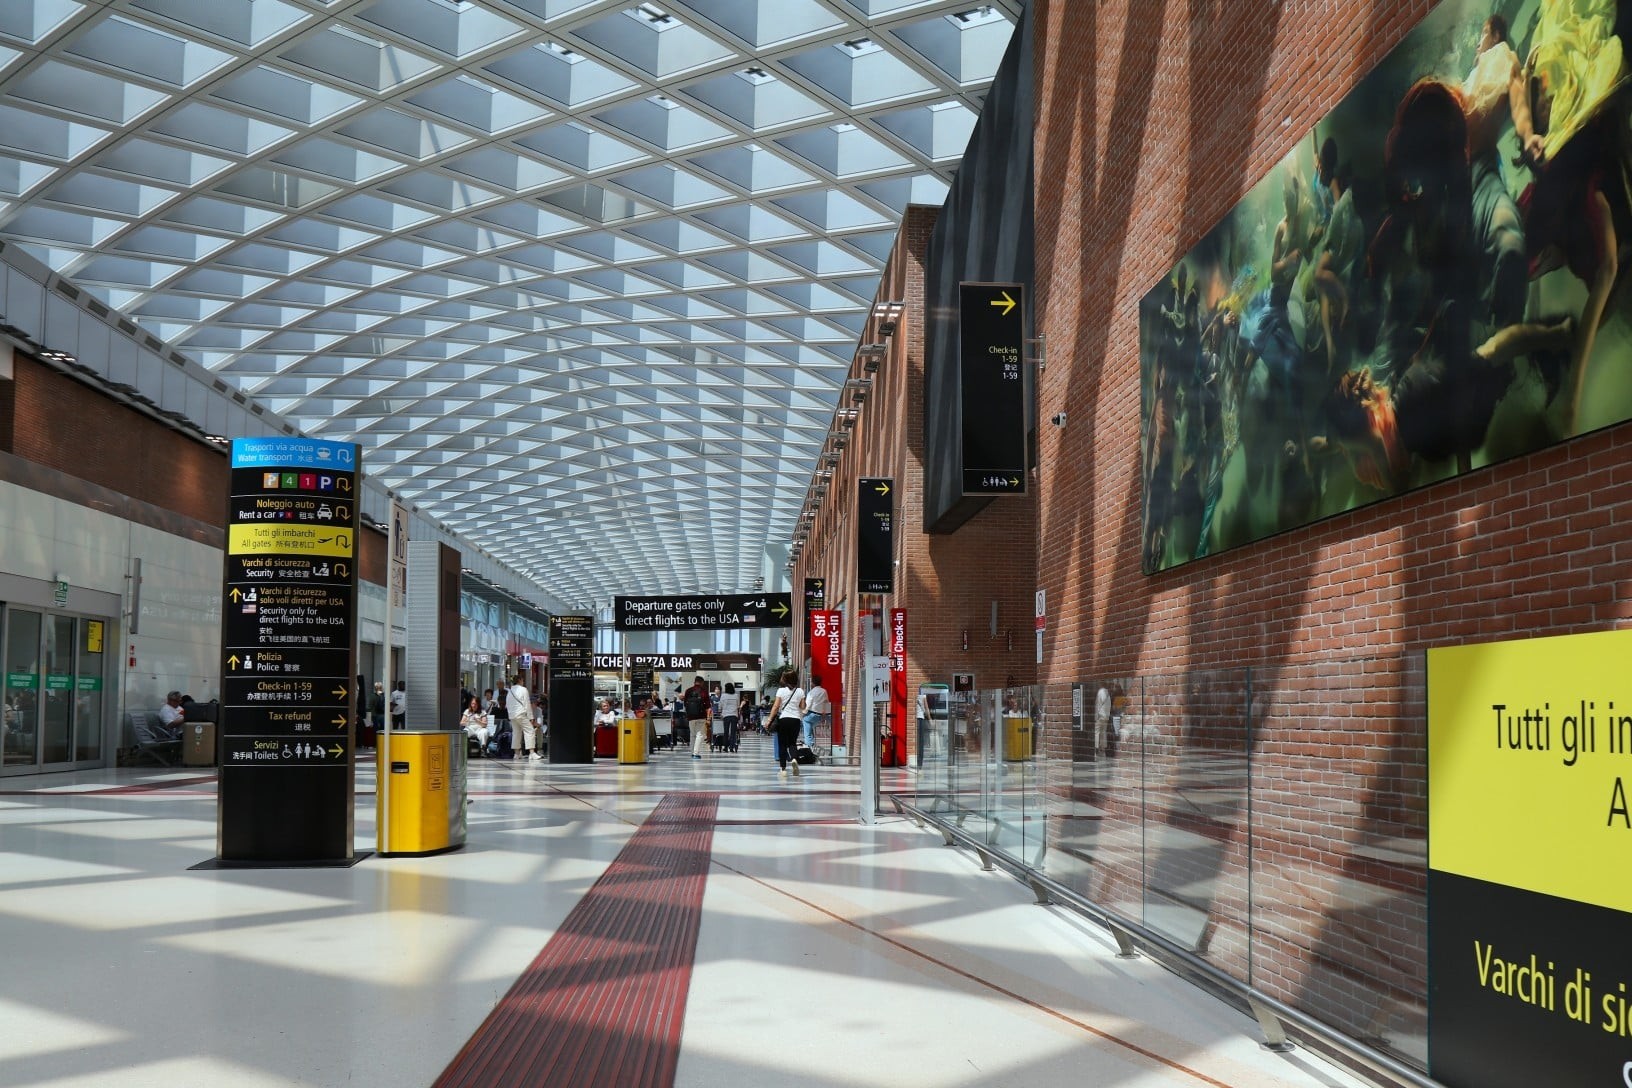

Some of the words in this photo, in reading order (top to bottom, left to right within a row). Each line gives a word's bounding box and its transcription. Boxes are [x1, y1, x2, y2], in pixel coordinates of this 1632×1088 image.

[988, 346, 1018, 354] Check-in
[244, 443, 273, 452] Trasporti
[276, 443, 287, 451] via
[238, 454, 256, 462] Water
[258, 454, 292, 462] transport
[286, 476, 292, 485] 4
[305, 477, 310, 486] 1
[320, 476, 331, 489] P
[256, 500, 292, 510] Noleggio
[239, 511, 255, 519] Rent
[254, 529, 269, 537] Tutti
[272, 529, 280, 538] gli
[282, 529, 315, 537] imbarchi
[252, 540, 271, 549] gates
[242, 559, 263, 567] Varchi
[246, 569, 274, 578] Security
[260, 587, 282, 595] Varchi
[293, 588, 326, 596] sicurezza
[625, 600, 673, 613] Departure
[676, 600, 701, 612] gates
[704, 599, 724, 611] only
[260, 607, 287, 615] Security
[289, 607, 305, 616] only
[259, 616, 279, 624] direct
[281, 616, 304, 625] flights
[625, 615, 652, 626] direct
[655, 614, 685, 627] flights
[688, 615, 698, 624] to
[700, 614, 716, 624] the
[719, 614, 739, 624] USA
[814, 615, 826, 637] Self
[894, 612, 903, 652] Check-in
[828, 615, 839, 665] Check-in
[636, 657, 665, 667] PIZZA
[671, 657, 692, 667] BAR
[257, 663, 280, 671] Police
[257, 682, 291, 691] Check-in
[294, 682, 312, 690] 1-59
[269, 712, 283, 720] Tax
[285, 712, 311, 720] refund
[1492, 702, 1550, 751] Tutti
[1562, 700, 1595, 766] gli
[254, 740, 278, 750] Servizi
[254, 751, 279, 760] Toilets
[1607, 776, 1632, 829] A
[1474, 940, 1554, 1011] Varchi
[1565, 967, 1590, 1024] di
